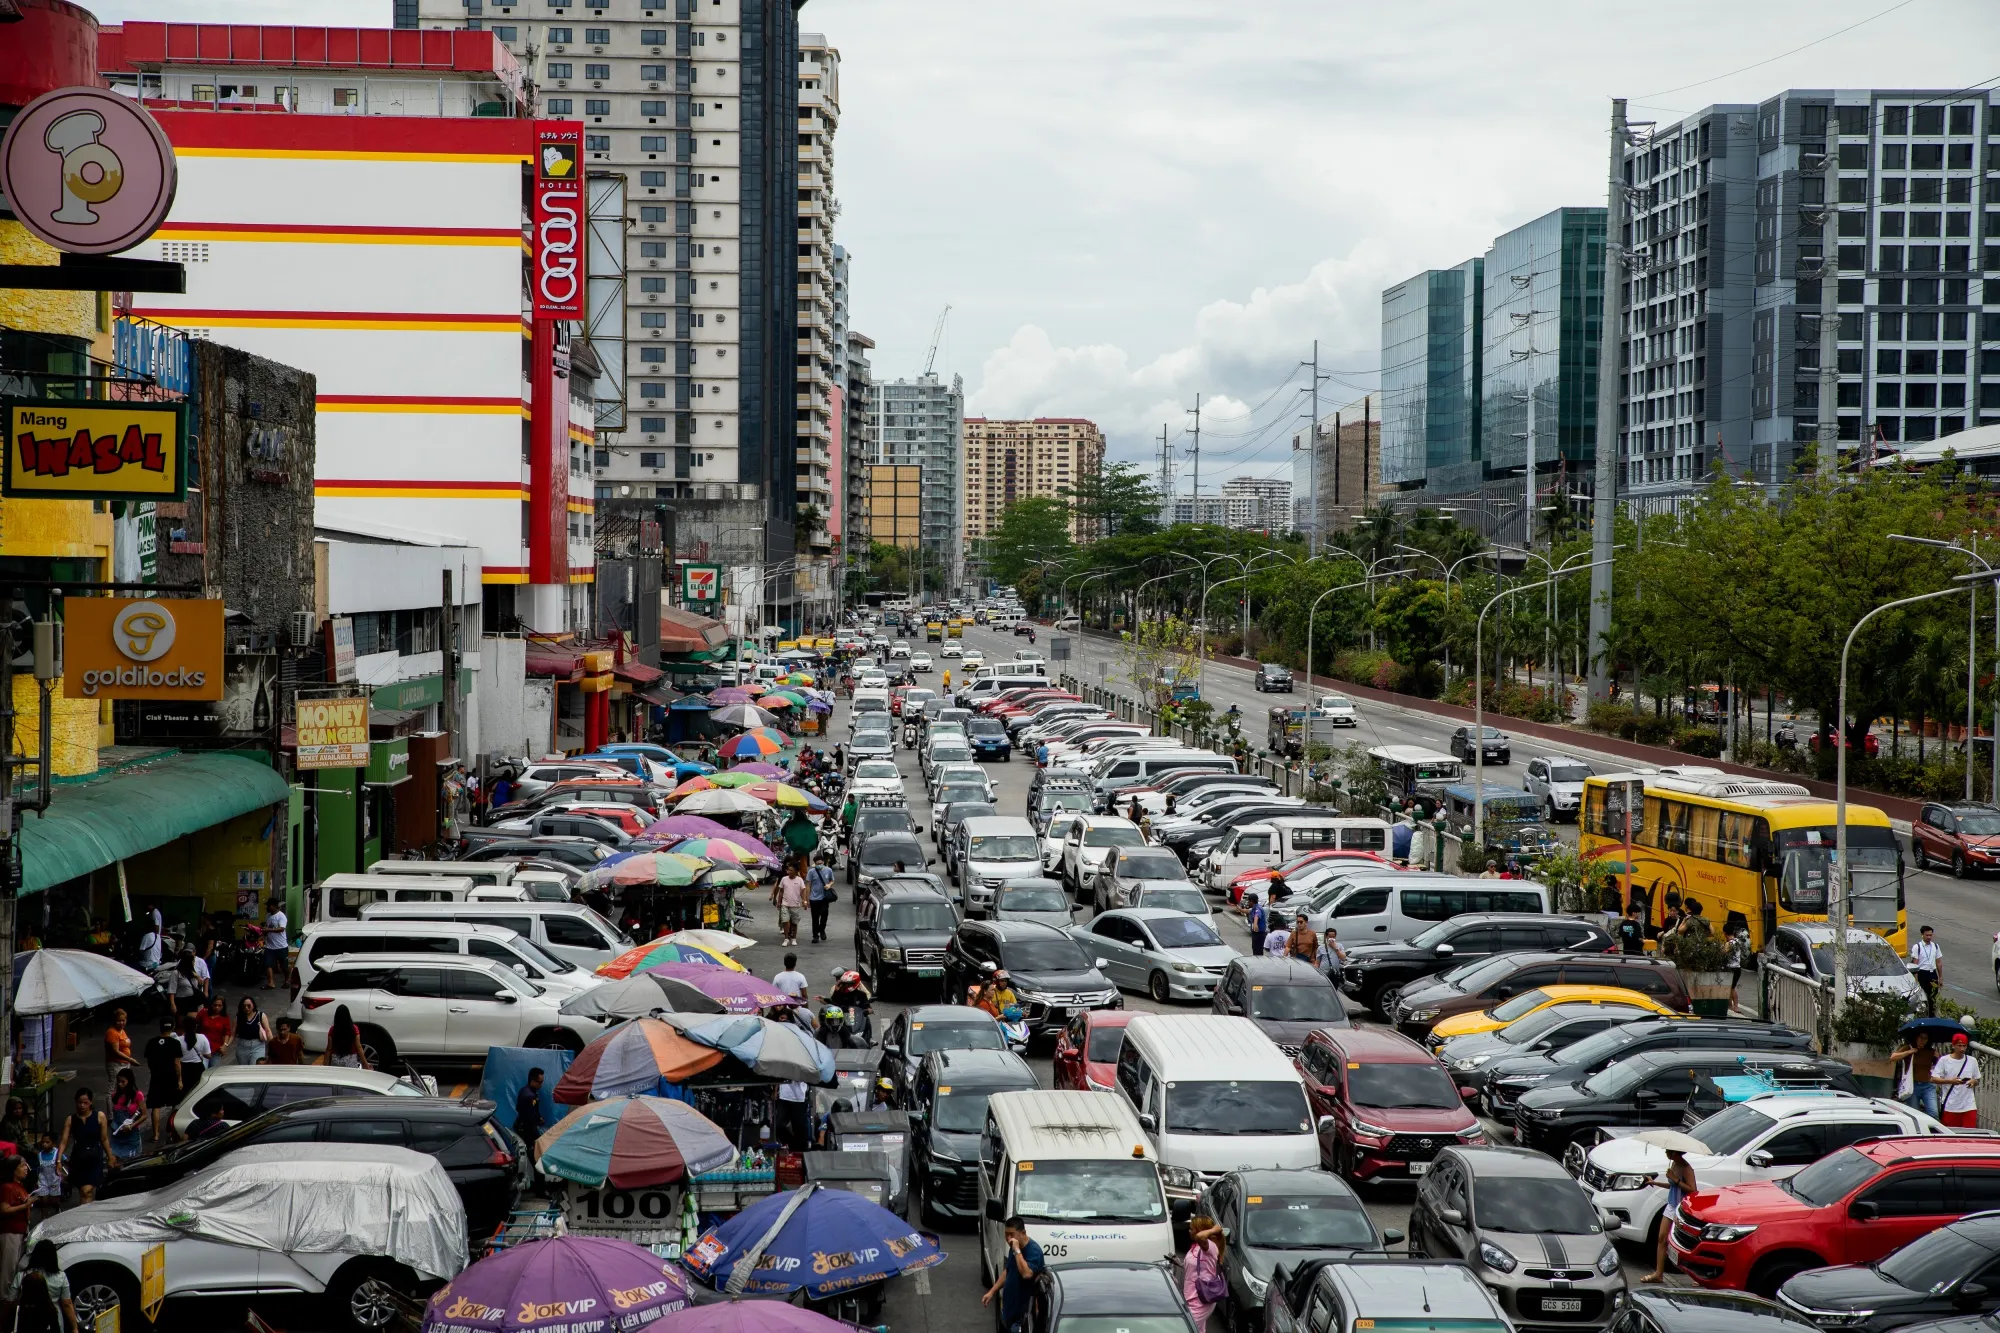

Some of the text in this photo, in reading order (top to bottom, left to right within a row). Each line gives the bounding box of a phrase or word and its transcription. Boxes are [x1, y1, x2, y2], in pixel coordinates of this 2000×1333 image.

[540, 131, 578, 139] ホテル ソウゴ
[541, 191, 577, 303] SOGO
[154, 331, 189, 394] CLUB
[20, 412, 67, 429] Mang
[17, 424, 167, 477] INASAL
[82, 665, 206, 696] goldilocks
[298, 705, 365, 728] MONEY
[298, 727, 366, 746] CHANGER
[320, 753, 351, 761] AVAILABLE
[576, 1191, 671, 1219] 100
[1091, 1232, 1127, 1241] pacific
[829, 1248, 880, 1268] OKVIP
[1043, 1244, 1068, 1256] 205
[625, 1281, 668, 1302] OKVIP
[745, 1279, 790, 1291] vip.com
[818, 1272, 888, 1293] okvip.com
[461, 1303, 506, 1321] OKVIP
[538, 1298, 597, 1318] OKVIP
[621, 1299, 685, 1329] LIÊN MINH OKVIP
[1542, 1301, 1580, 1310] GCS 5168
[571, 1320, 605, 1333] OKVIP
